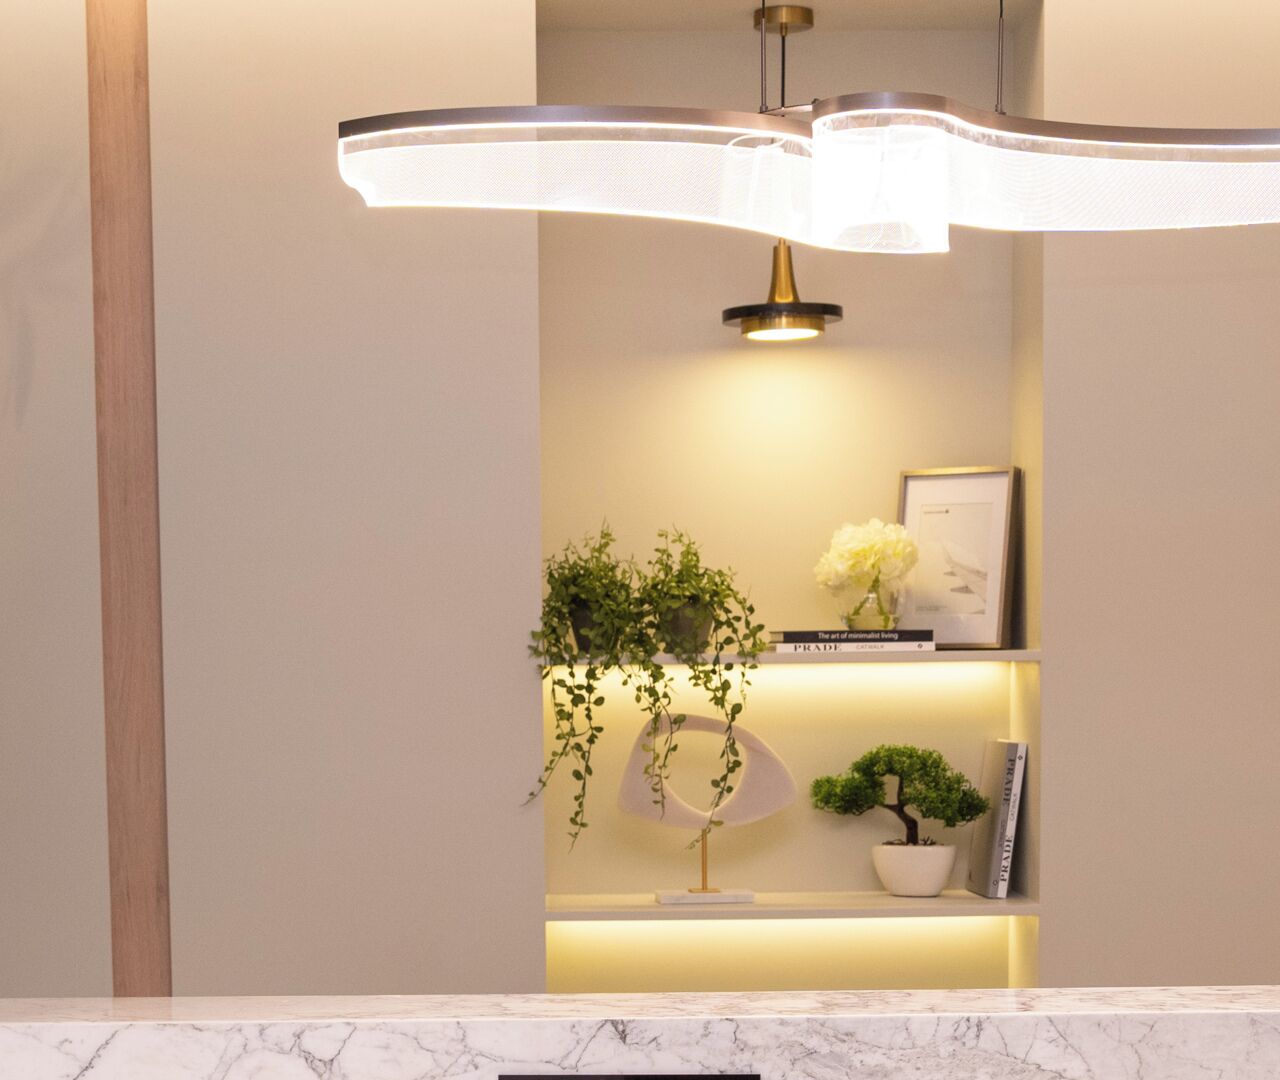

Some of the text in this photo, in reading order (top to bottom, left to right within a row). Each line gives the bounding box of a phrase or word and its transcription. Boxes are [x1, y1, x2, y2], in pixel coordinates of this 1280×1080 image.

[818, 632, 830, 640] The
[840, 632, 848, 640] of
[848, 632, 880, 640] minimalist
[881, 632, 899, 641] living
